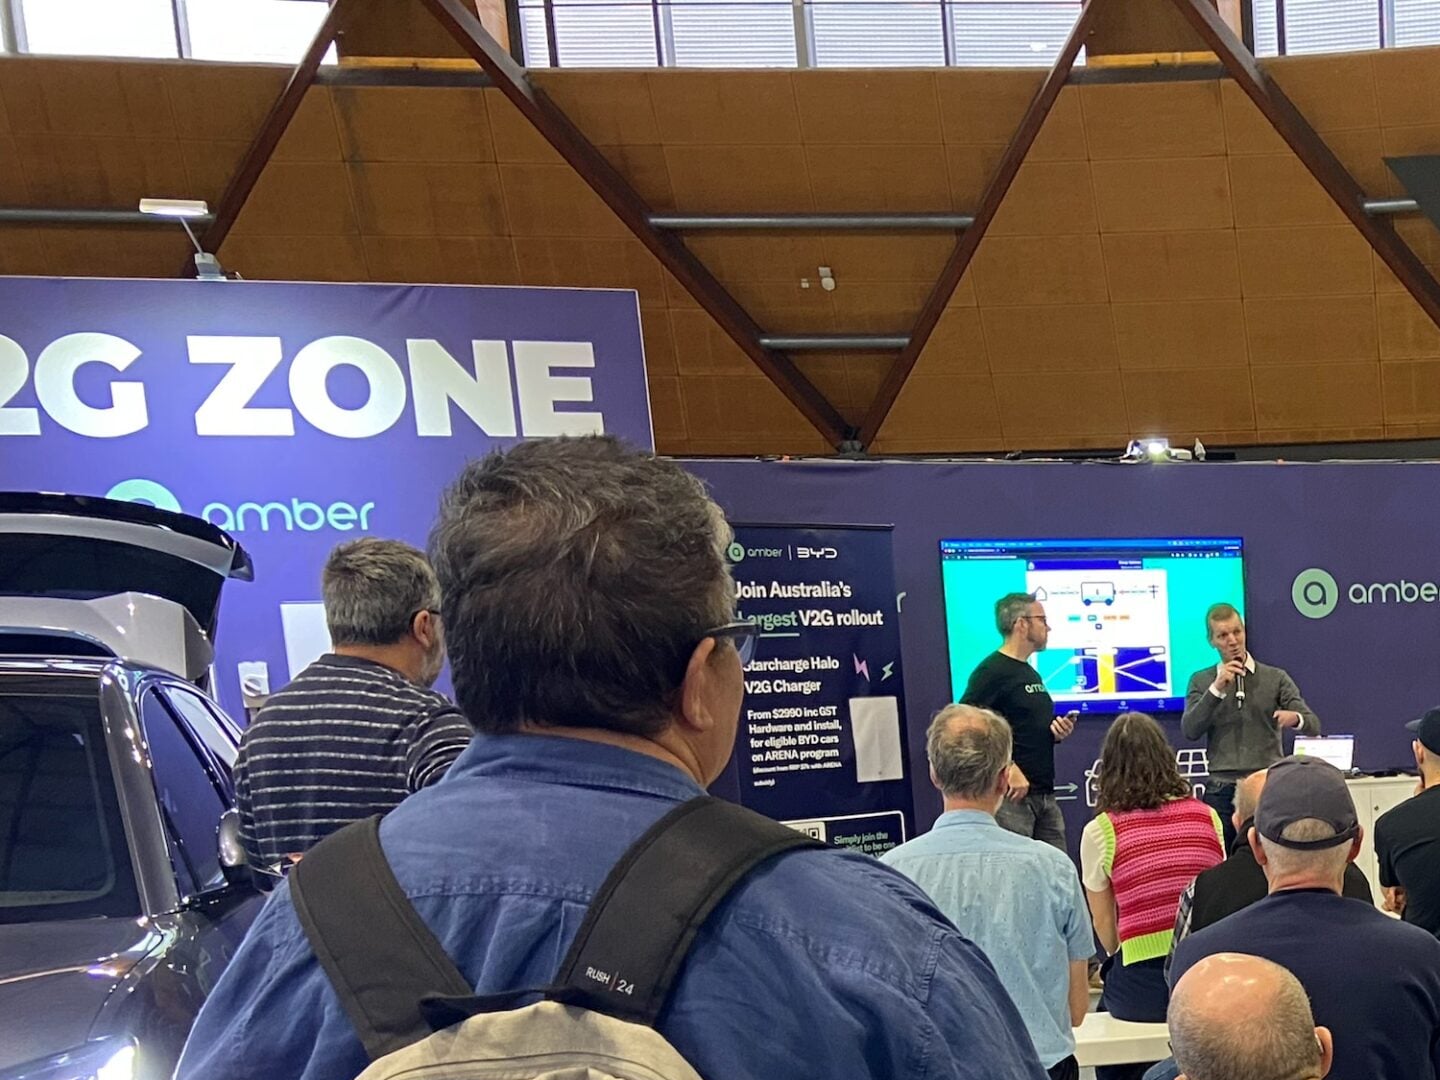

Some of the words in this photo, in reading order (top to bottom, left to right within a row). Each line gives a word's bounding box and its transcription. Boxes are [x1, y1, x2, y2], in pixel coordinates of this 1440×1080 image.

[186, 335, 605, 438] ZONE
[201, 498, 375, 531] amber
[747, 548, 782, 557] amber
[797, 547, 837, 558] BYD
[736, 581, 767, 598] Join
[769, 581, 852, 598] Australia's
[799, 609, 834, 627] V2G
[837, 608, 883, 626] rollout
[811, 656, 839, 669] Halo
[744, 680, 772, 694] V2G
[773, 679, 821, 694] Charger
[747, 709, 771, 720] From
[772, 707, 802, 719] $2990
[804, 707, 818, 717] inc
[819, 705, 837, 716] GST
[749, 723, 793, 734] Hardware
[794, 721, 812, 731] and
[813, 719, 842, 730] install,
[750, 737, 764, 748] for
[764, 735, 797, 749] eligible
[798, 735, 819, 745] BYD
[820, 735, 839, 743] cars
[752, 753, 763, 762] on
[765, 749, 799, 761] ARENA
[800, 749, 839, 760] program
[585, 966, 611, 984] RUSH
[616, 979, 634, 995] 24
